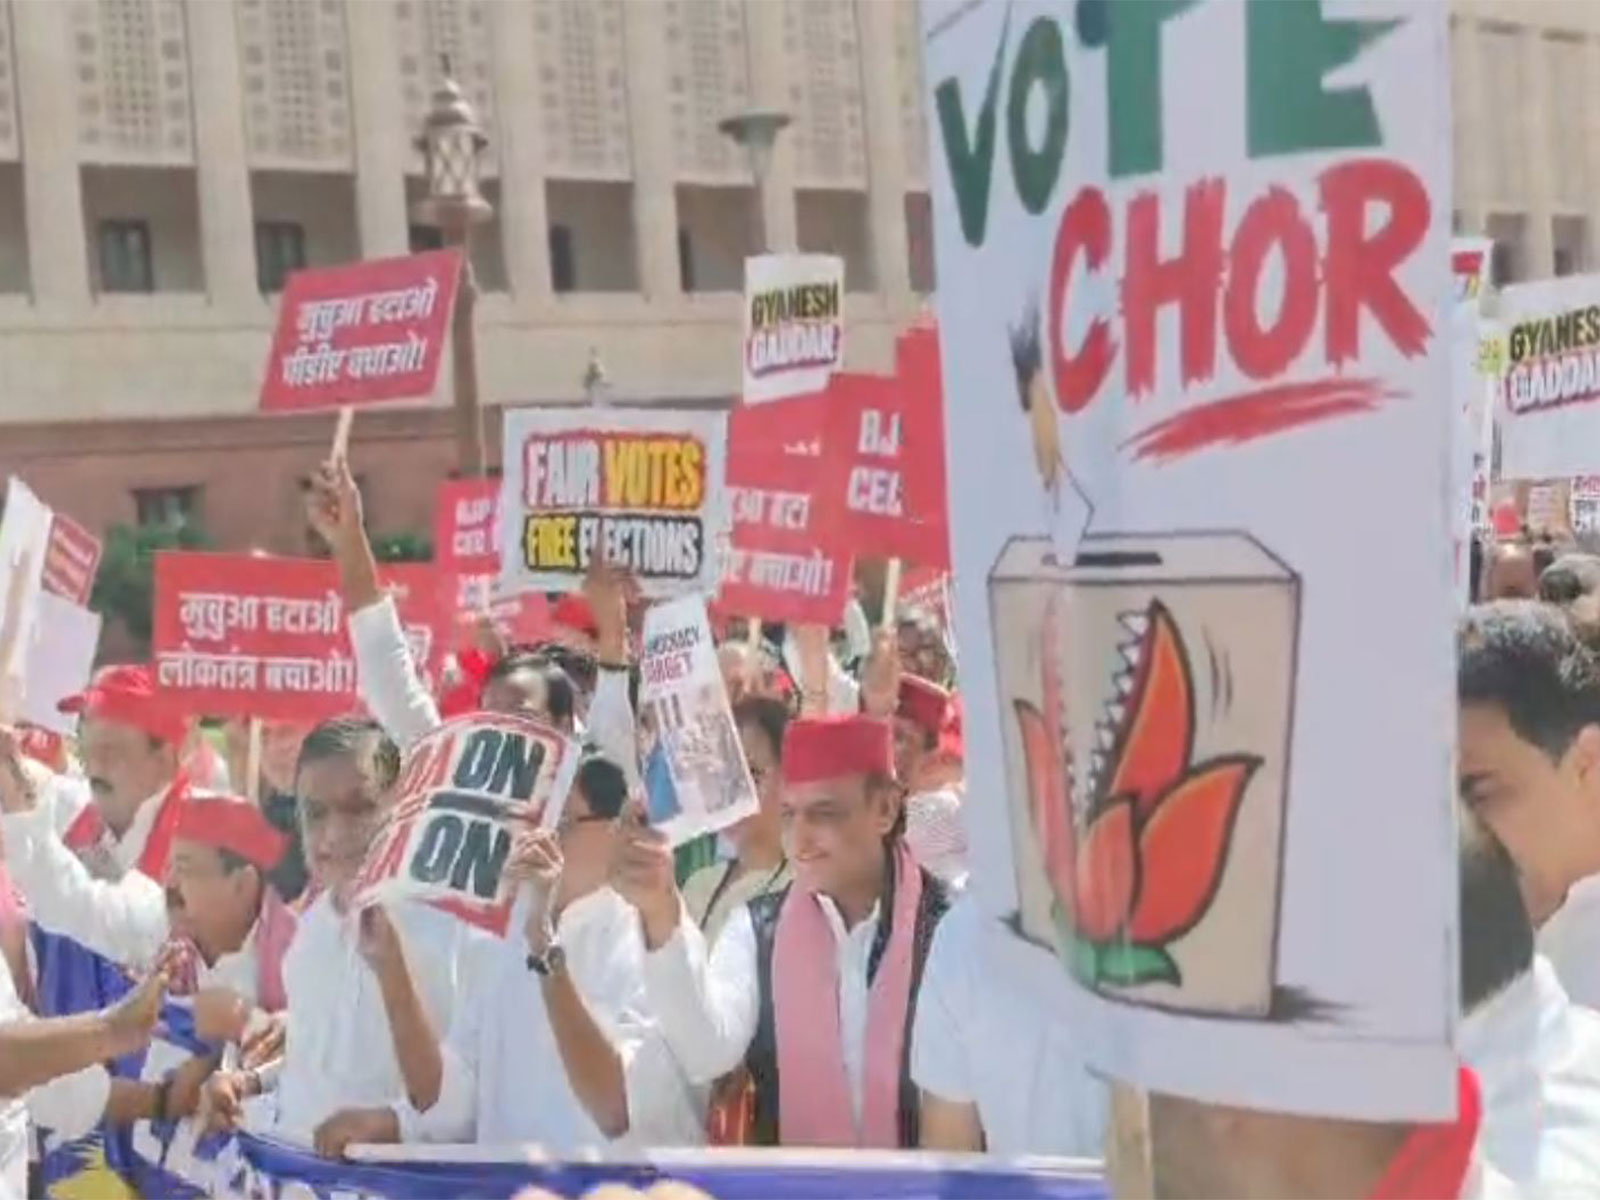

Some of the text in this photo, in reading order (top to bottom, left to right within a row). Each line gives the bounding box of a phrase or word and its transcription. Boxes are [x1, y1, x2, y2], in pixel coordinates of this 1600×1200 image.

[935, 0, 1406, 247] VOTE
[752, 281, 839, 331] GYANESH
[1048, 158, 1434, 413] CHOR
[1510, 306, 1600, 362] GYANES
[1511, 349, 1600, 411] GADDA
[527, 440, 600, 508] FAIR
[603, 439, 703, 508] VOTES
[527, 517, 577, 568] FREE
[179, 591, 259, 641] मुचुआ
[260, 588, 344, 635] हटाओ
[157, 640, 258, 690] लोकतंत्र
[453, 730, 547, 801] ON
[409, 814, 512, 901] ON
